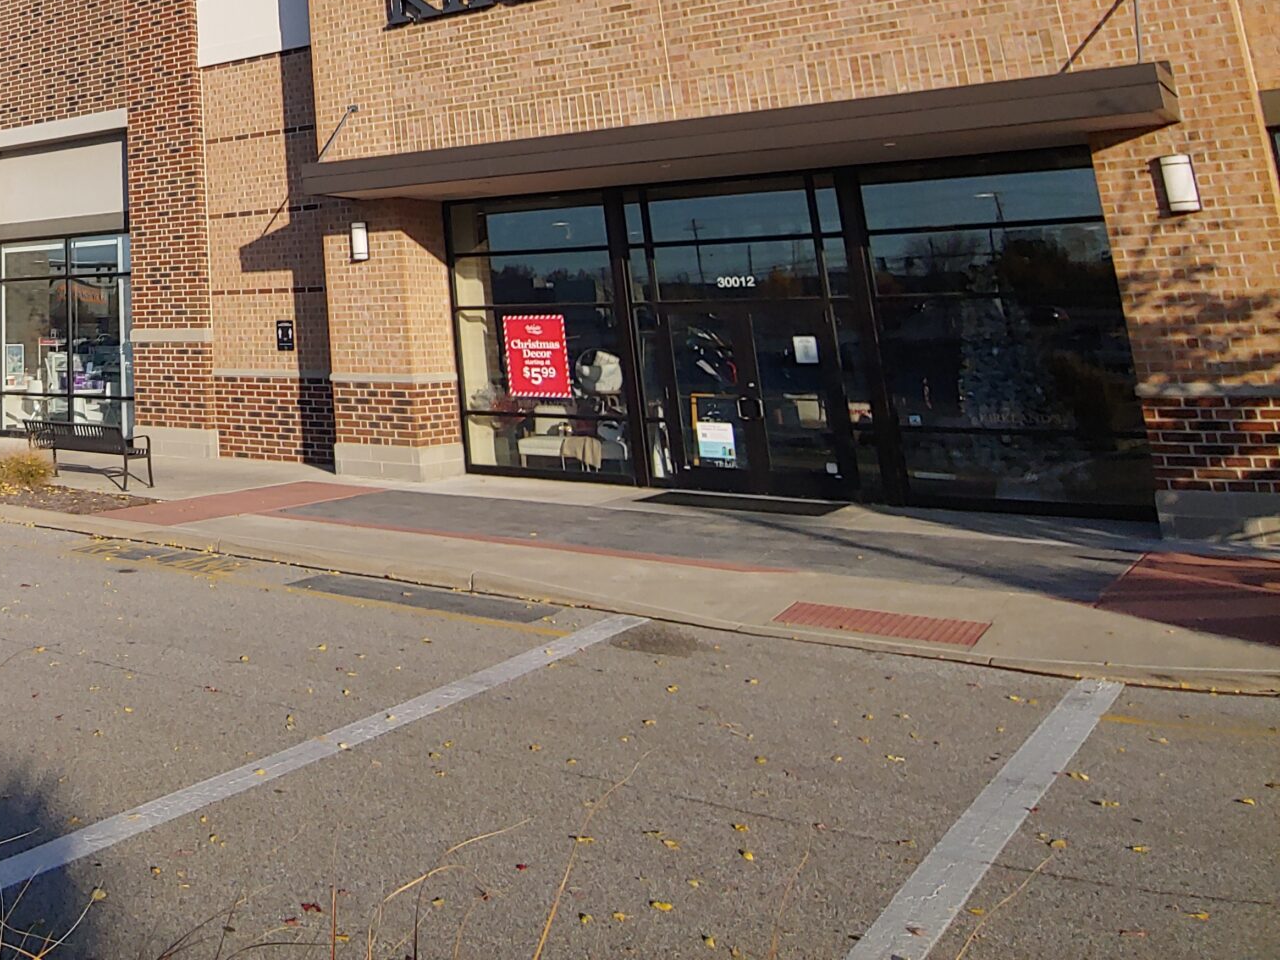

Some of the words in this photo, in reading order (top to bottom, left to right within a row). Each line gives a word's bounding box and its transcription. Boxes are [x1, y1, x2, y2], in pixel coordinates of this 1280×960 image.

[716, 276, 756, 288] 30012
[510, 339, 560, 349] Christmas
[522, 349, 552, 358] Decor
